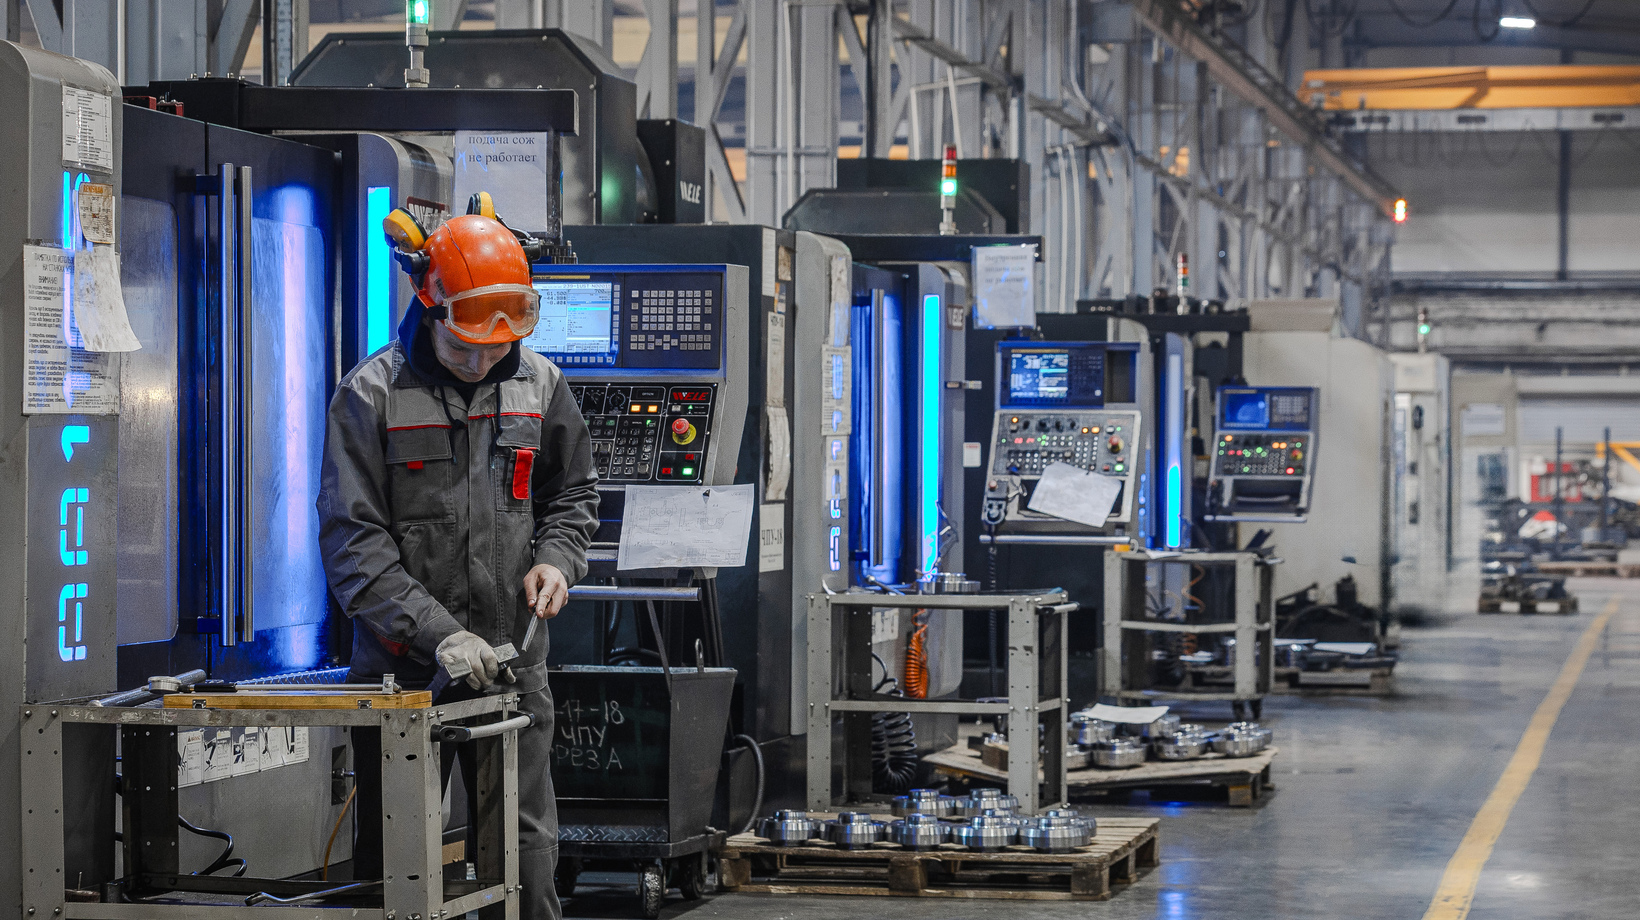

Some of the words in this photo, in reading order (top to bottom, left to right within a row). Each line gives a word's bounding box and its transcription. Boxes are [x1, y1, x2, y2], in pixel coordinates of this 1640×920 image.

[468, 136, 509, 146] подача
[512, 136, 535, 145] сож
[468, 153, 482, 163] не
[485, 151, 537, 165] работает
[680, 180, 701, 204] WELE
[672, 391, 710, 401] WELE
